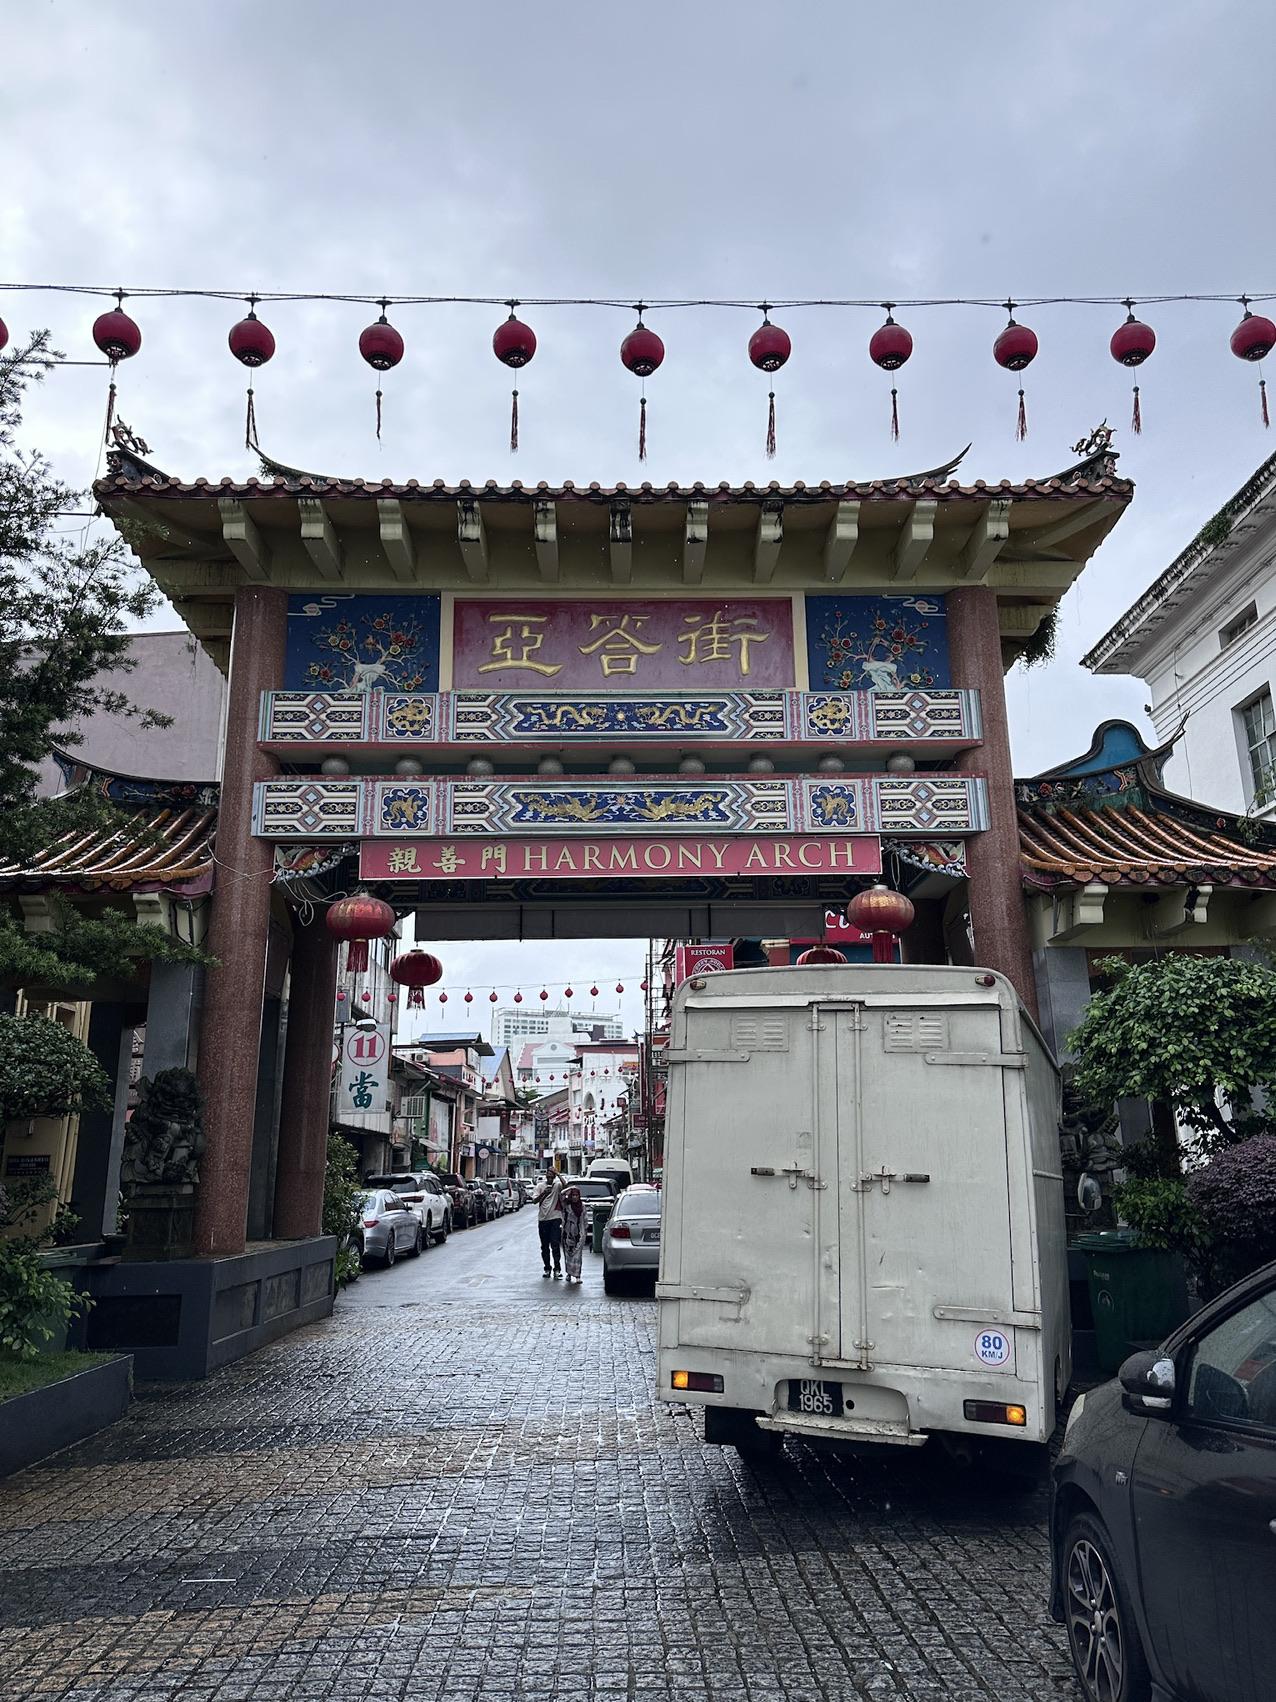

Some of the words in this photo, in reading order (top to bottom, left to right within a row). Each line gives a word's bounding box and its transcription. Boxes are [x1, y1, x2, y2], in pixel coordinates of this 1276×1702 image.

[477, 610, 771, 678] 亞答街
[386, 845, 508, 874] 親善門
[522, 843, 731, 872] HARMONY
[743, 841, 857, 869] ARCH
[353, 1034, 378, 1059] 11
[348, 1071, 379, 1109] 當
[981, 1335, 1003, 1350] 80
[981, 1350, 1003, 1359] KM/J
[800, 1379, 830, 1397] QKL
[799, 1394, 833, 1414] 1965
